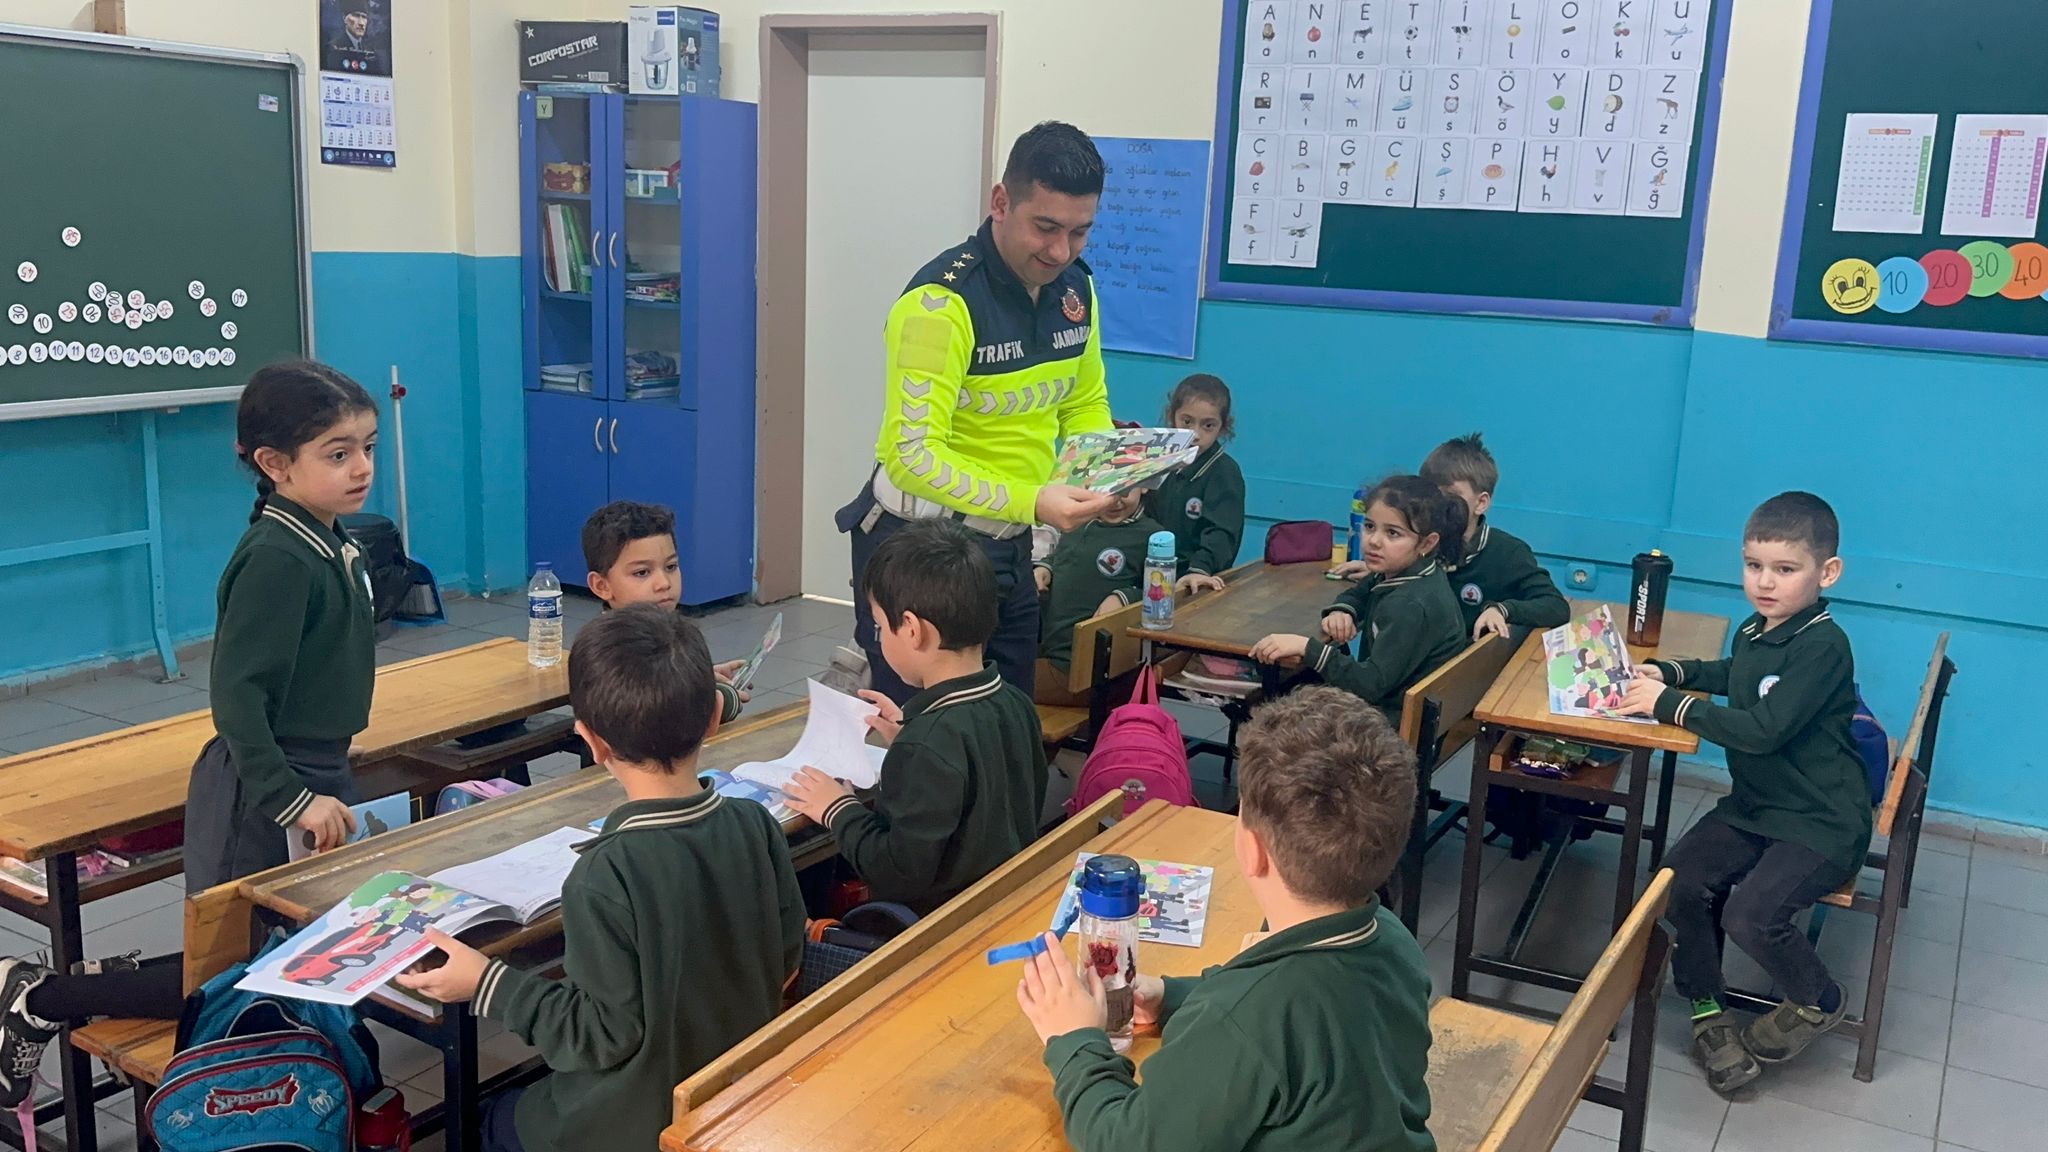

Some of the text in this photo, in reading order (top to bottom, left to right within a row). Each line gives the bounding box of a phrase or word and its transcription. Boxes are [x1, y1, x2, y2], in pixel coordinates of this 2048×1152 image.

[1264, 4, 1276, 20] A
[1309, 4, 1323, 20] N
[1361, 4, 1370, 20] E
[1409, 4, 1419, 20] T
[1511, 3, 1521, 20] L
[1562, 2, 1578, 18] O
[1618, 2, 1631, 18] K
[1675, 2, 1689, 18] U
[528, 35, 598, 67] CORPOSTAR
[1262, 47, 1270, 57] a
[1308, 49, 1317, 59] n
[1357, 50, 1364, 60] e
[1561, 49, 1570, 59] o
[1615, 41, 1622, 59] k
[1671, 51, 1681, 60] u
[1260, 72, 1270, 89] R
[1347, 73, 1364, 90] M
[1399, 70, 1413, 92] Ü
[1449, 73, 1460, 91] S
[1498, 70, 1515, 92] Ö
[1553, 72, 1566, 90] Y
[1608, 74, 1623, 92] D
[1662, 75, 1677, 93] Z
[541, 104, 548, 114] Y
[1258, 115, 1266, 126] r
[1346, 117, 1358, 128] m
[1397, 117, 1406, 129] ü
[1446, 121, 1453, 131] s
[1498, 118, 1507, 131] ö
[1549, 118, 1559, 133] y
[1605, 115, 1615, 132] d
[1659, 123, 1669, 134] z
[1253, 138, 1668, 168] Ç B G C Ş P H V Ğ
[1252, 182, 1260, 194] ç
[1297, 177, 1305, 193] b
[1339, 181, 1348, 196] g
[1439, 188, 1445, 201] ş
[1486, 187, 1496, 202] p
[1542, 185, 1550, 202] h
[1593, 193, 1603, 203] v
[1648, 189, 1659, 210] ğ
[1250, 203, 1303, 219] F J
[65, 229, 79, 243] 85
[1248, 240, 1299, 259] f j
[1973, 252, 1999, 279] 30
[2014, 256, 2042, 286] 40
[1883, 270, 1908, 296] 10
[1931, 263, 1959, 290] 20
[61, 305, 75, 319] 25
[143, 305, 156, 319] 50
[203, 300, 216, 315] 35
[37, 317, 49, 329] 10
[1635, 584, 1648, 632] SPORT
[214, 1083, 290, 1114] SPEEDY
